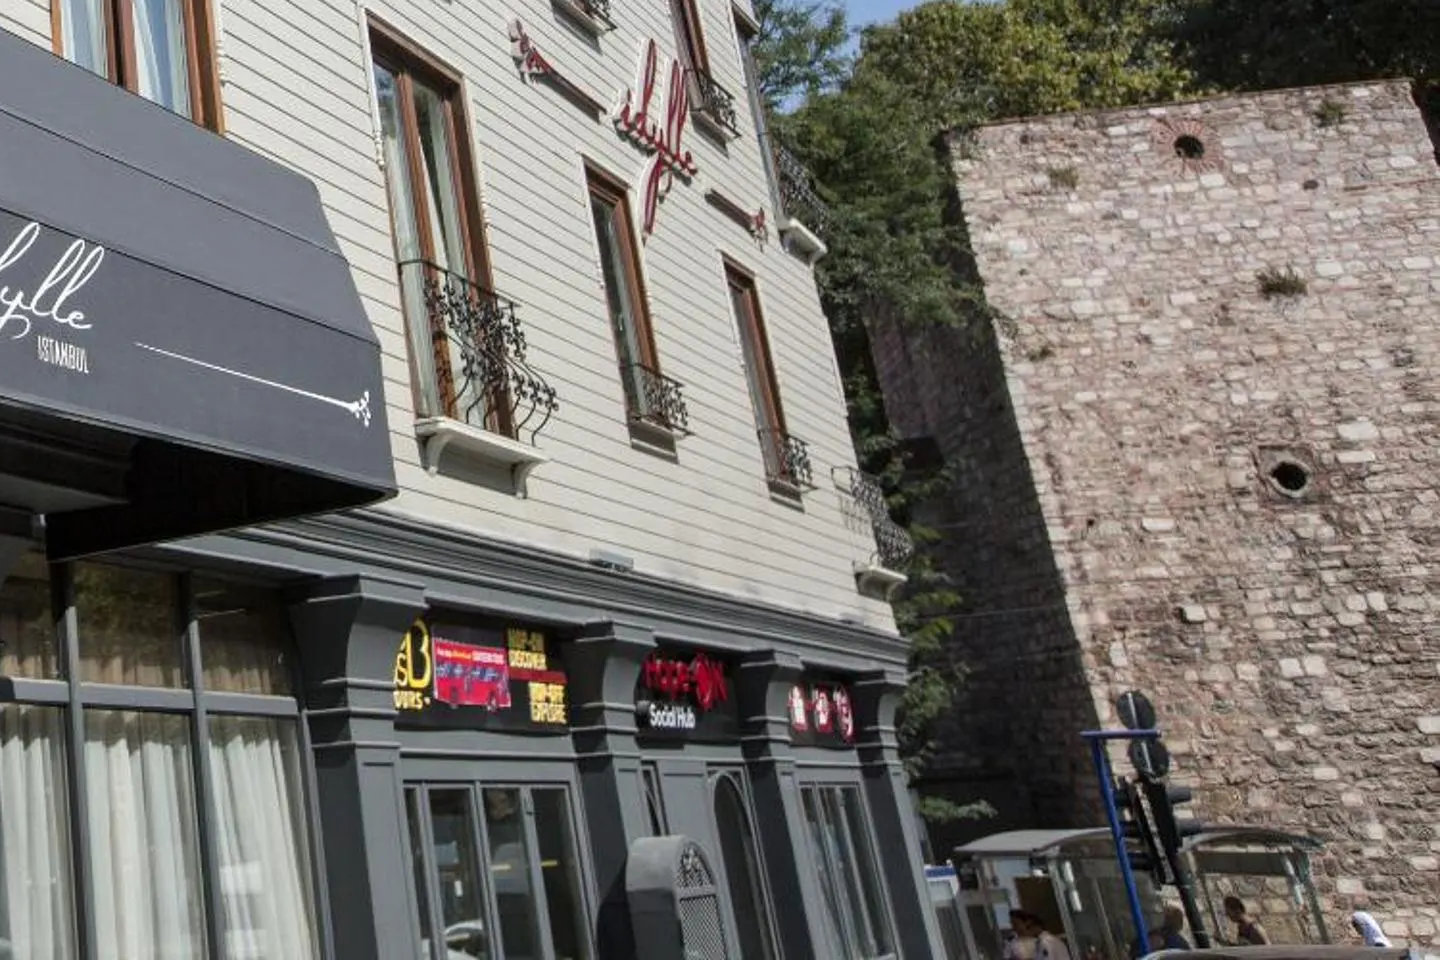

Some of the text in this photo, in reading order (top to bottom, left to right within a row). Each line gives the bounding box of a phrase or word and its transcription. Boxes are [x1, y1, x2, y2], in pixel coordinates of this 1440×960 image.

[614, 38, 698, 235] idylle
[37, 336, 90, 374] ISTANBUL
[649, 703, 696, 729] Social Hub
